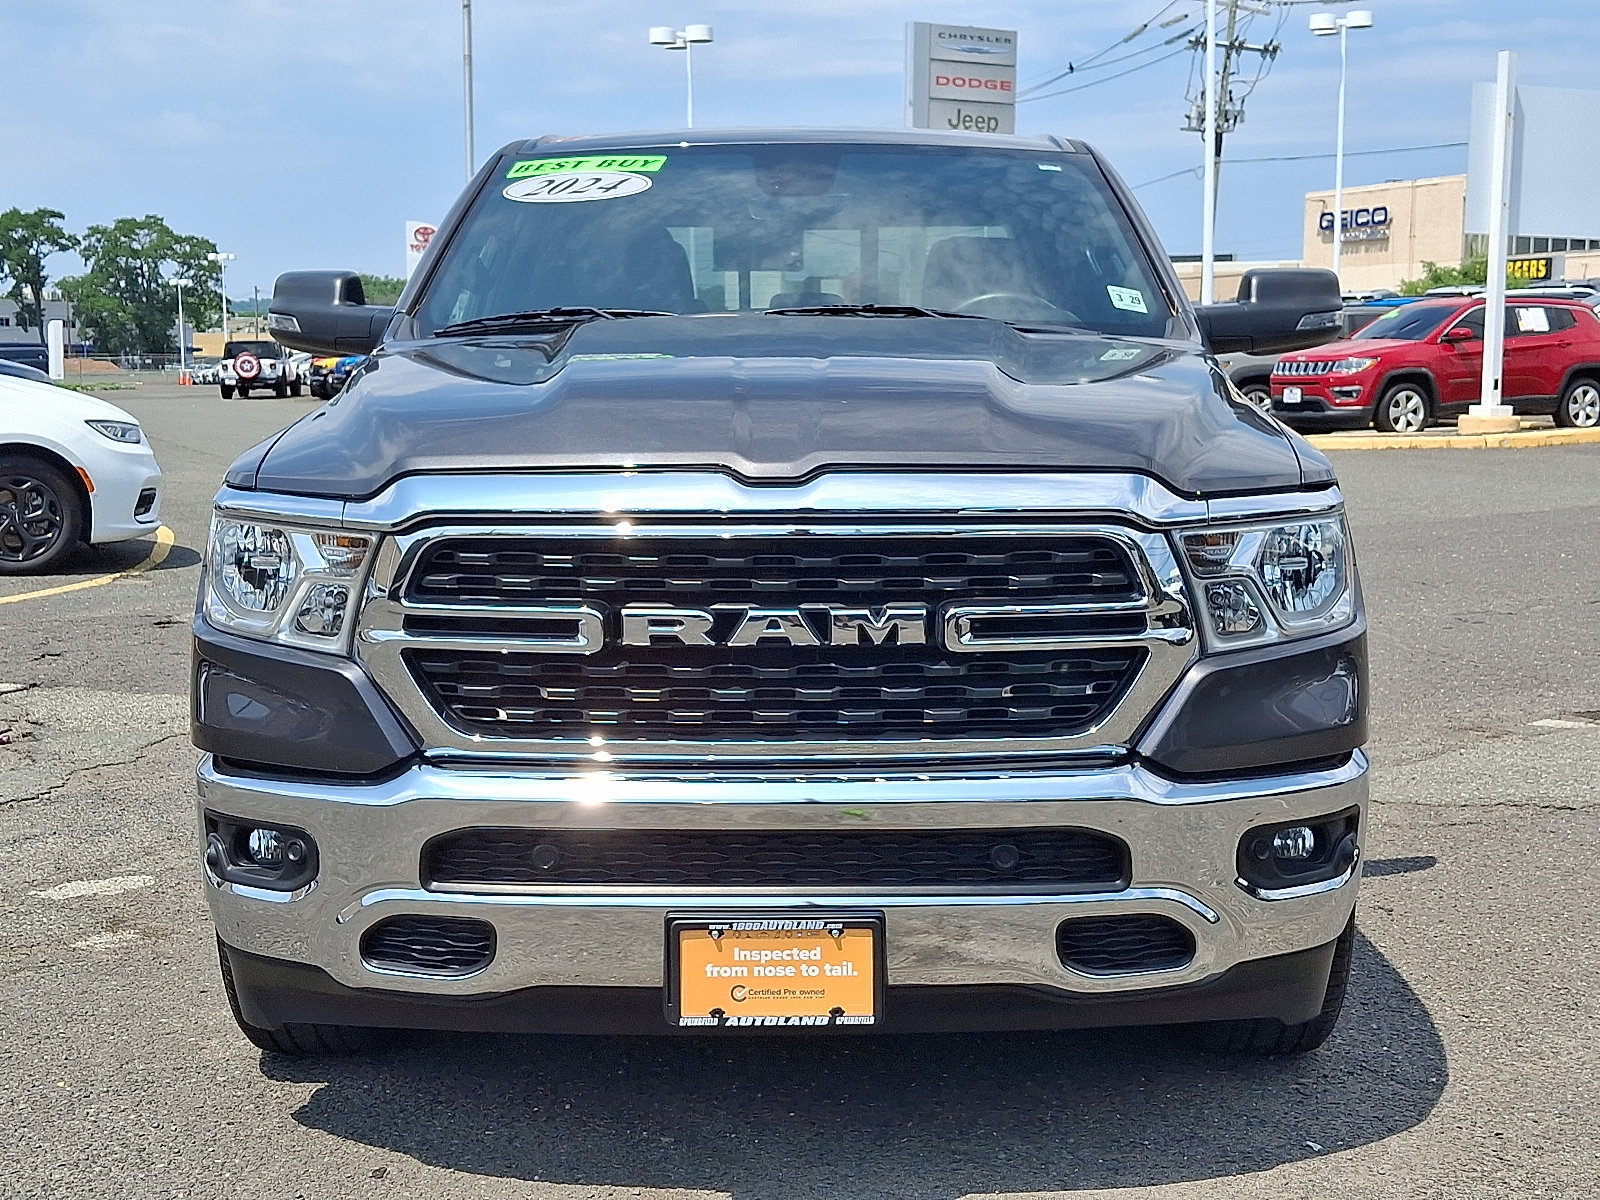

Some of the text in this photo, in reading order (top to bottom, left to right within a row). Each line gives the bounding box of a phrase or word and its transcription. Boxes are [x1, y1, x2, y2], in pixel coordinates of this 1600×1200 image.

[938, 32, 1012, 45] CHRYSLER
[935, 75, 1012, 91] DODGE
[947, 108, 999, 133] Jeep
[513, 158, 661, 174] BEST BUY
[520, 177, 632, 197] 2024
[1320, 206, 1388, 230] GEICO
[620, 603, 927, 646] RAM
[733, 946, 822, 964] Inspected
[705, 960, 859, 977] from nose to tail.
[748, 988, 782, 996] Certified
[799, 988, 826, 996] owned
[724, 1015, 830, 1027] AUTOLAND
